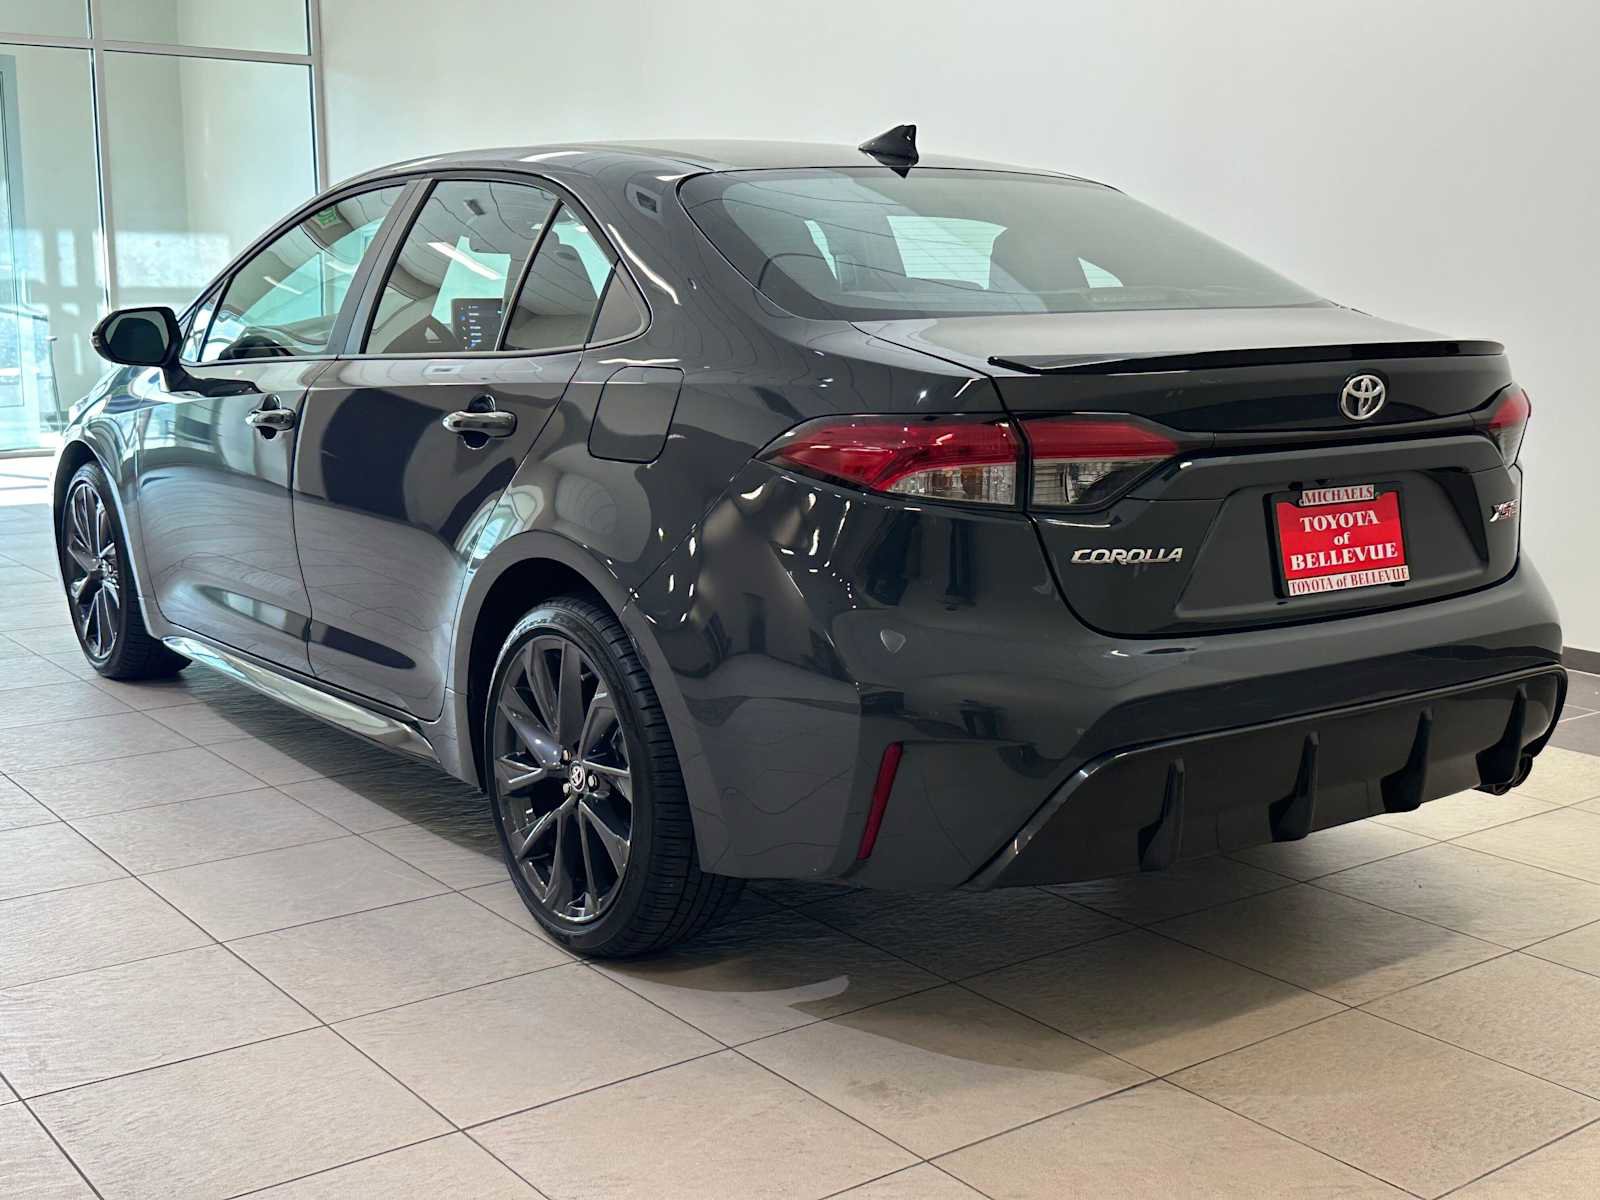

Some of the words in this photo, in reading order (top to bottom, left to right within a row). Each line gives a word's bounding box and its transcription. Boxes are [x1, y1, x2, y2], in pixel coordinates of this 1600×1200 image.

[1303, 487, 1374, 504] MICHAELS
[1300, 510, 1380, 533] TOYOTA
[1333, 531, 1351, 546] of
[1071, 547, 1184, 565] COROLLA
[1290, 542, 1399, 571] BELLEVUE
[1290, 577, 1334, 594] TOYOTA
[1336, 575, 1348, 588] of
[1351, 567, 1408, 586] BELLEVUE
